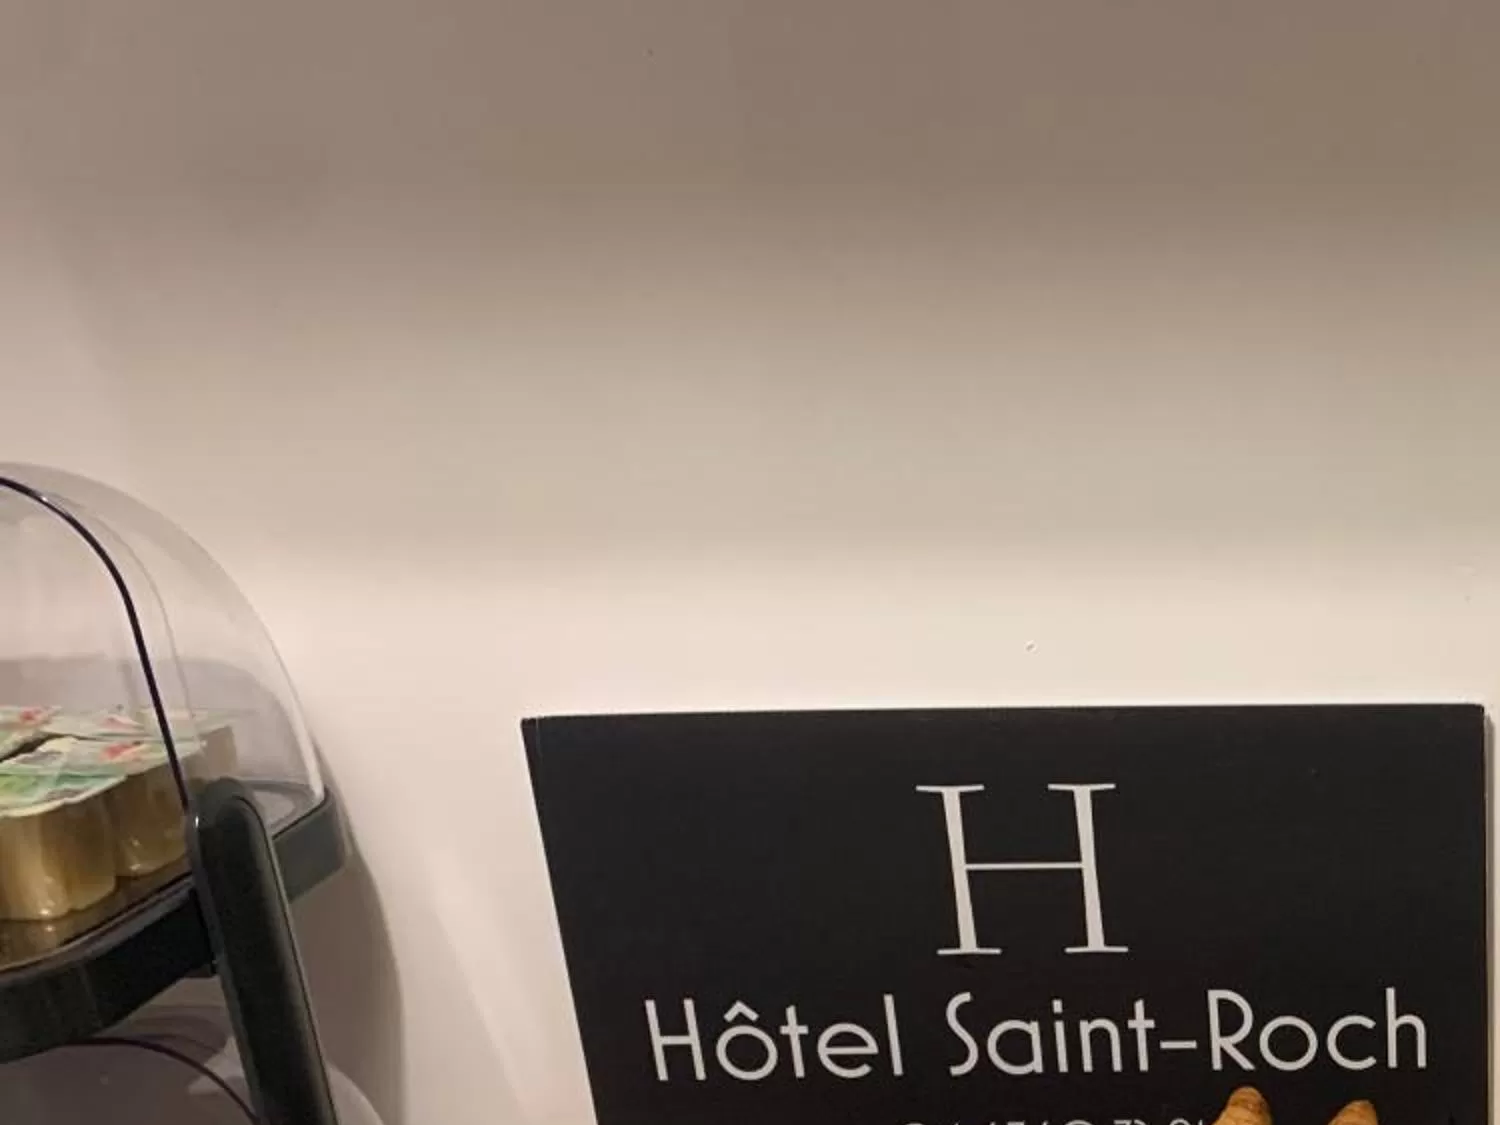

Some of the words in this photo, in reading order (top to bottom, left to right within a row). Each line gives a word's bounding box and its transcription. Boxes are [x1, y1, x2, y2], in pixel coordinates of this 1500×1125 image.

[915, 783, 1129, 955] H
[645, 993, 903, 1082] Hôtel
[947, 986, 1428, 1078] Saint-Roch
